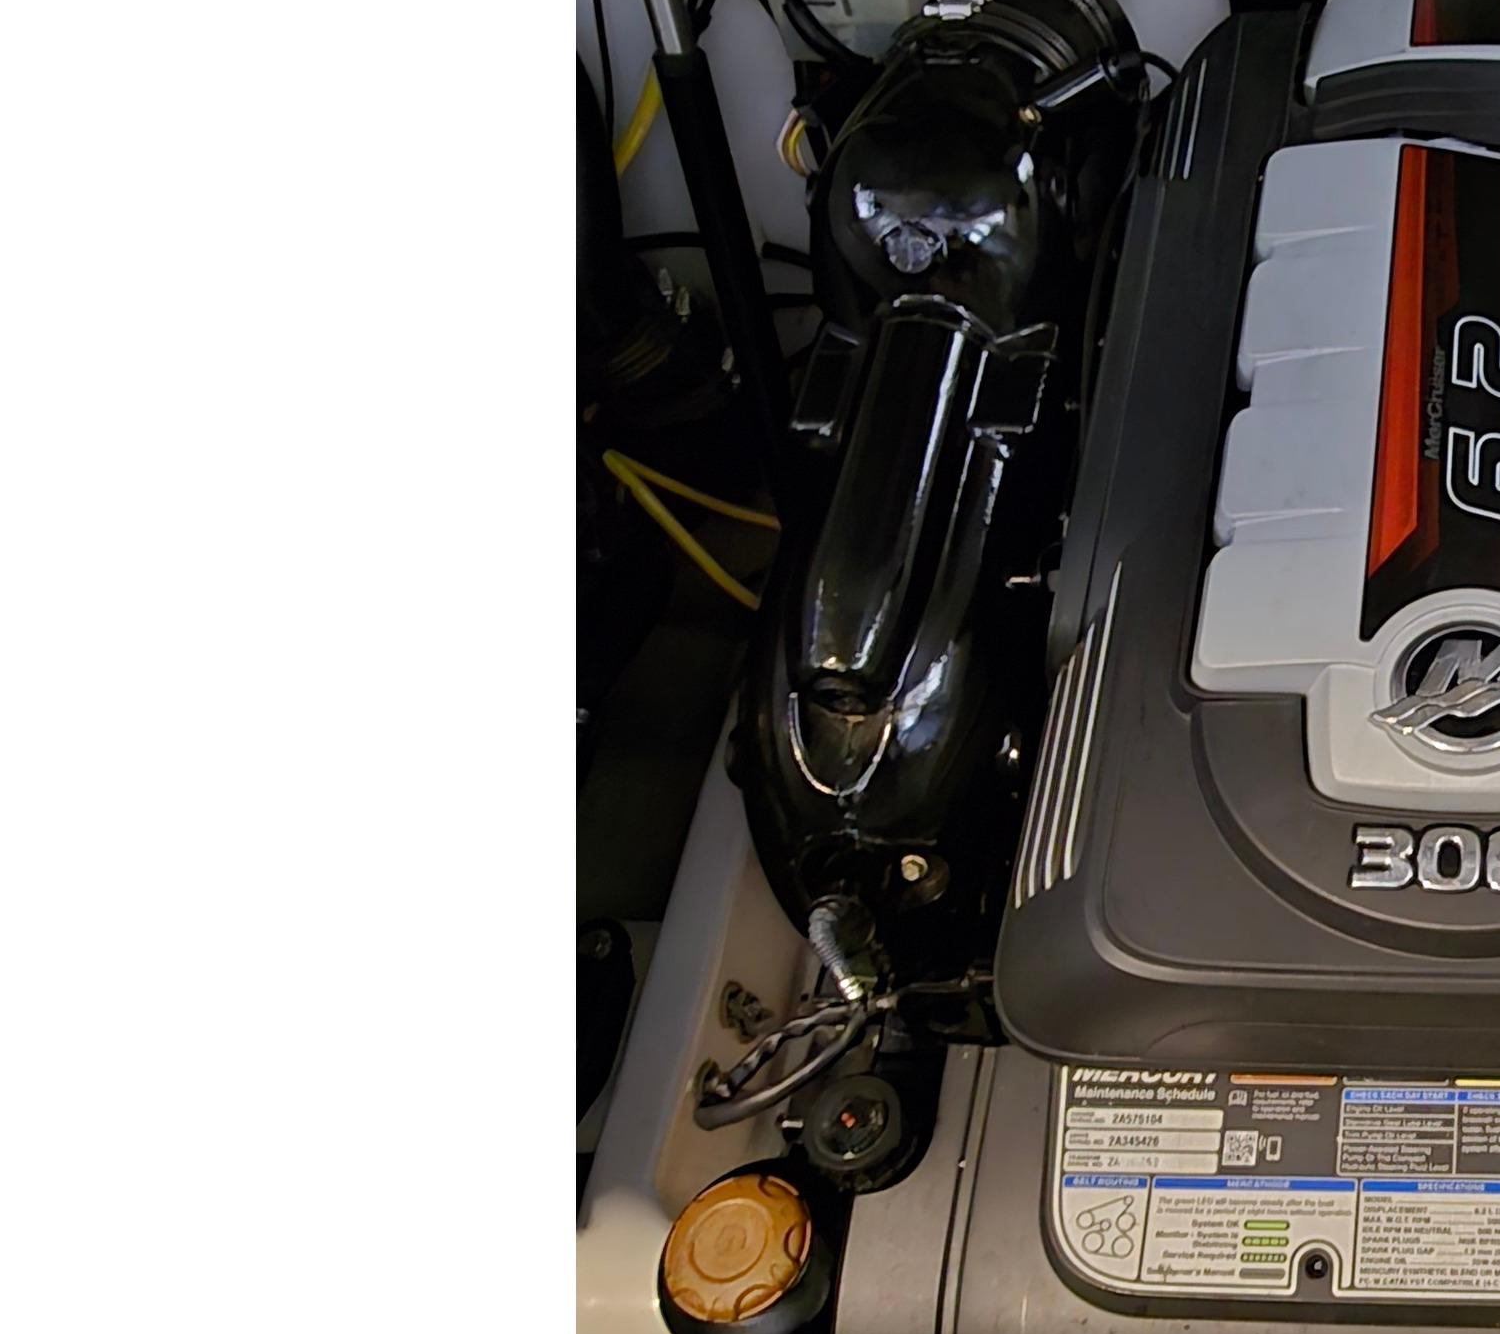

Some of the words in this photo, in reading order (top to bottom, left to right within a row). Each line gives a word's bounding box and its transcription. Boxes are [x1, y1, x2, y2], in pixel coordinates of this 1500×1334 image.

[1424, 345, 1446, 460] MerCruiser
[1074, 1085, 1155, 1100] Maintenance
[1156, 1086, 1216, 1102] Schedule
